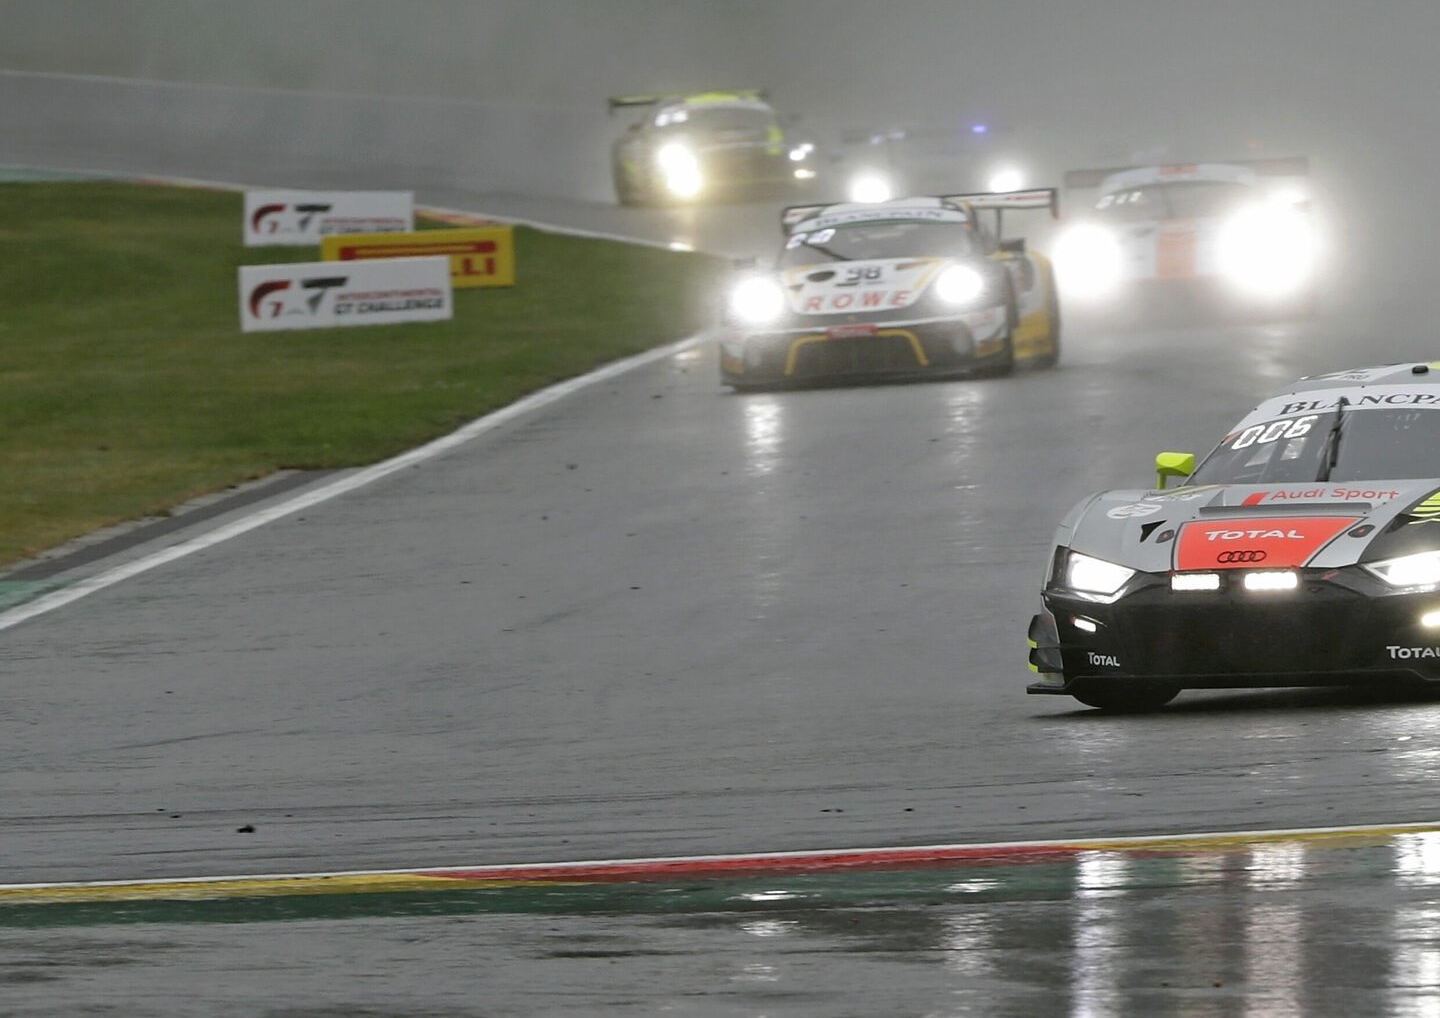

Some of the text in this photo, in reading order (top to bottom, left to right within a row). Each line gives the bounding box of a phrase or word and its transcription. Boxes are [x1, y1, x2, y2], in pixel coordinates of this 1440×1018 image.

[804, 290, 911, 312] ROWE
[1232, 415, 1319, 450] 006
[1271, 487, 1399, 502] Audi Sport
[1205, 529, 1305, 542] TOTAL
[1088, 652, 1120, 667] TOTAL
